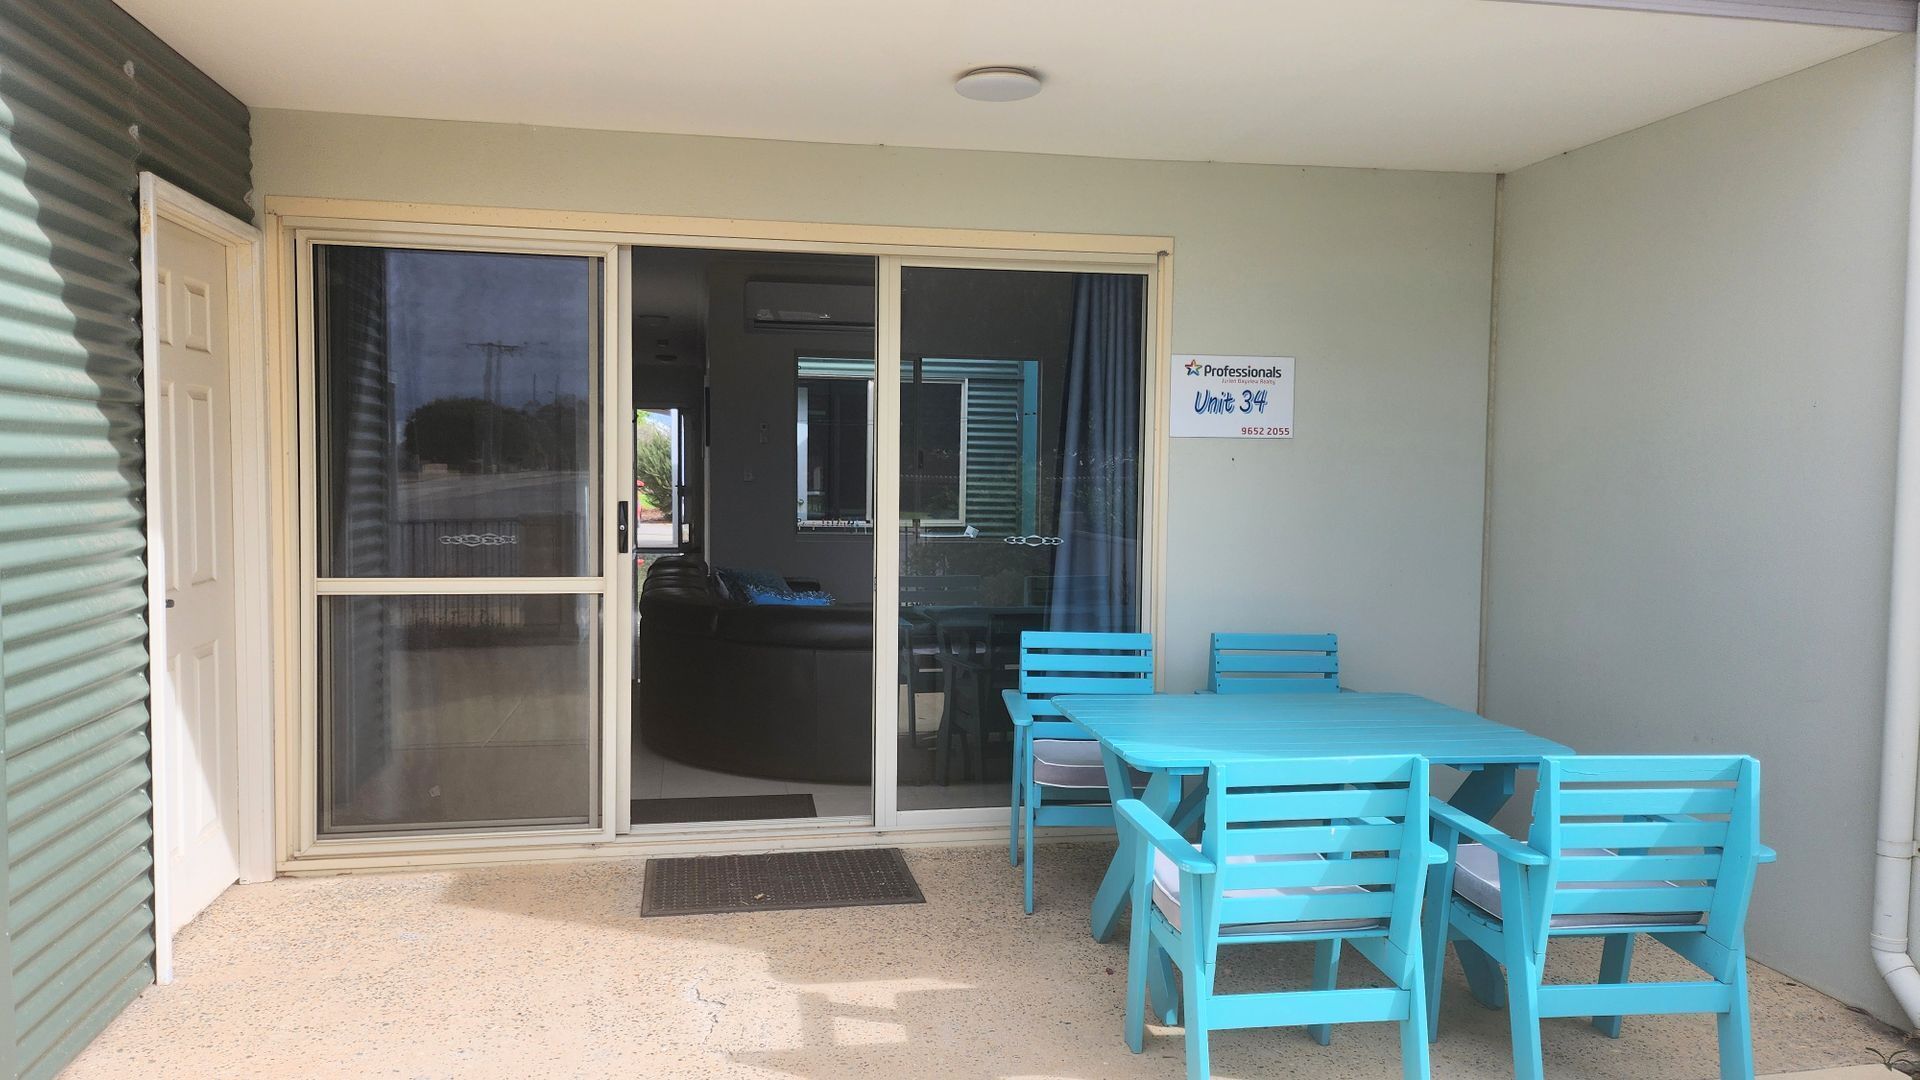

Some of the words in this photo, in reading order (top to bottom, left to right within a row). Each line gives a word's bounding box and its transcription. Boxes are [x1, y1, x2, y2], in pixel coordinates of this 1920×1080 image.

[1204, 364, 1282, 378] Professionals
[1194, 389, 1236, 414] Unit
[1239, 389, 1268, 414] 34
[1241, 427, 1264, 436] 9652
[1267, 427, 1290, 436] 2055
